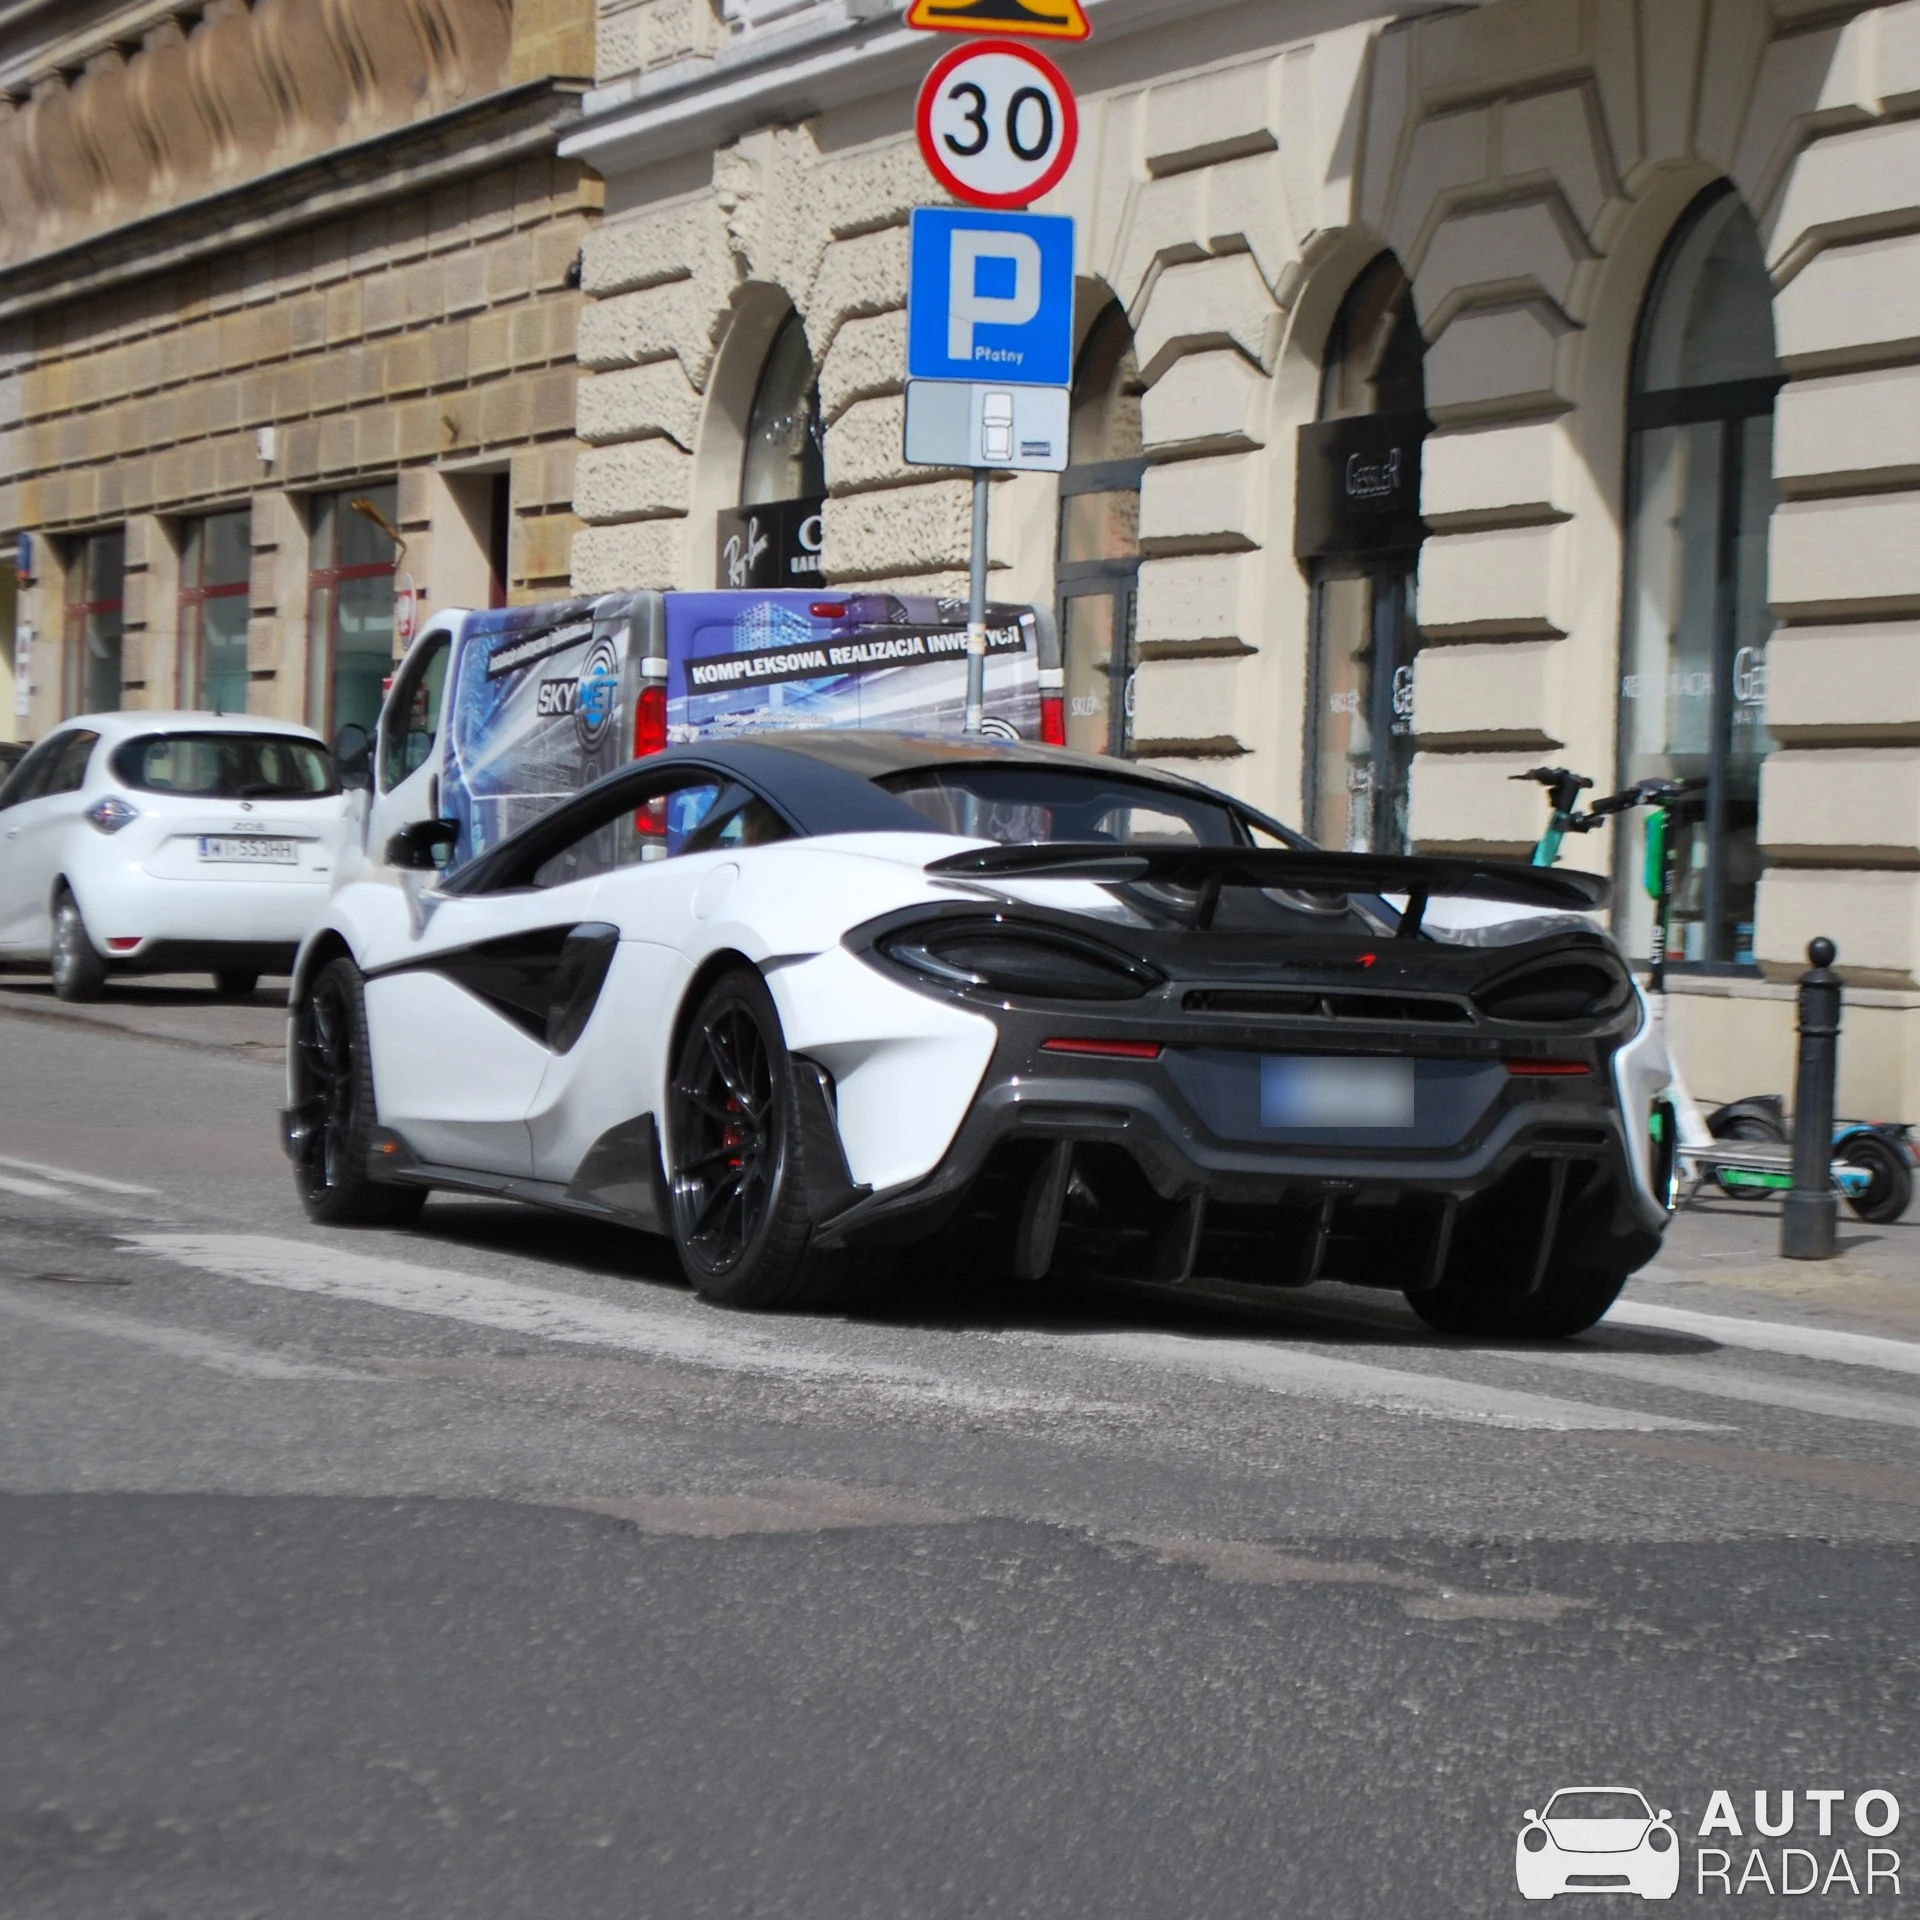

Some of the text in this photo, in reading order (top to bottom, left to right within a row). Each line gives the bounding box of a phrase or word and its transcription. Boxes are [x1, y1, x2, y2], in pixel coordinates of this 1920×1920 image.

[943, 82, 1054, 161] 30
[947, 228, 1042, 360] P
[692, 624, 1021, 685] KOMPLEKSOWA REALIZACJA INWEYCJI
